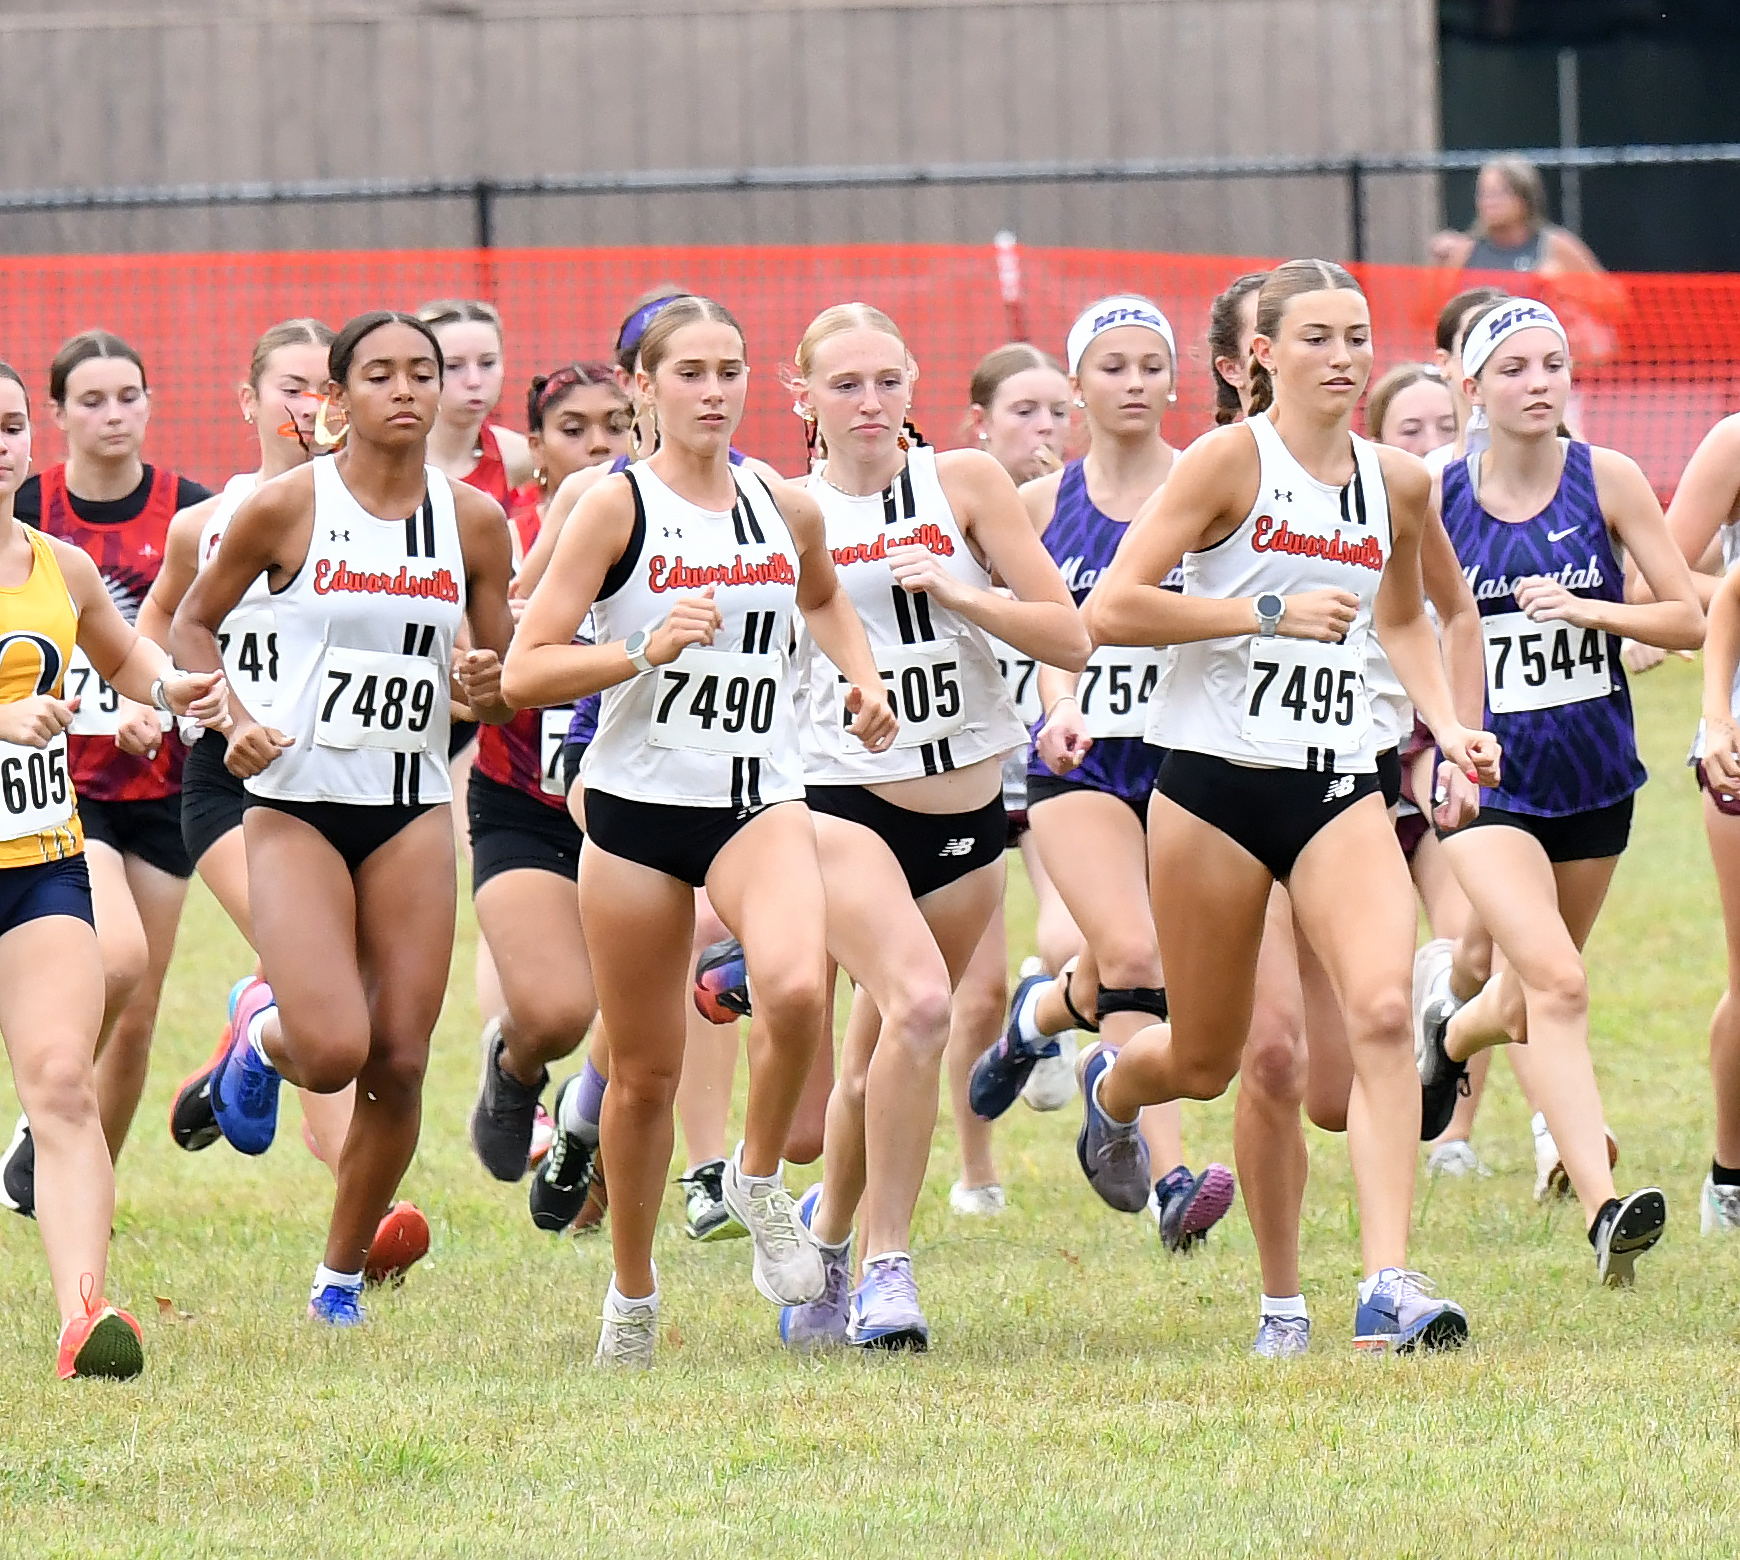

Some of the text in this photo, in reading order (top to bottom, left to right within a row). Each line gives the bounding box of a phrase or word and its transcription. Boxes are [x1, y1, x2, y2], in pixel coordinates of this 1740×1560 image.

[1489, 627, 1605, 690] 7544
[320, 669, 435, 732] 7489
[656, 670, 777, 734] 7490
[1249, 660, 1357, 727] 7495
